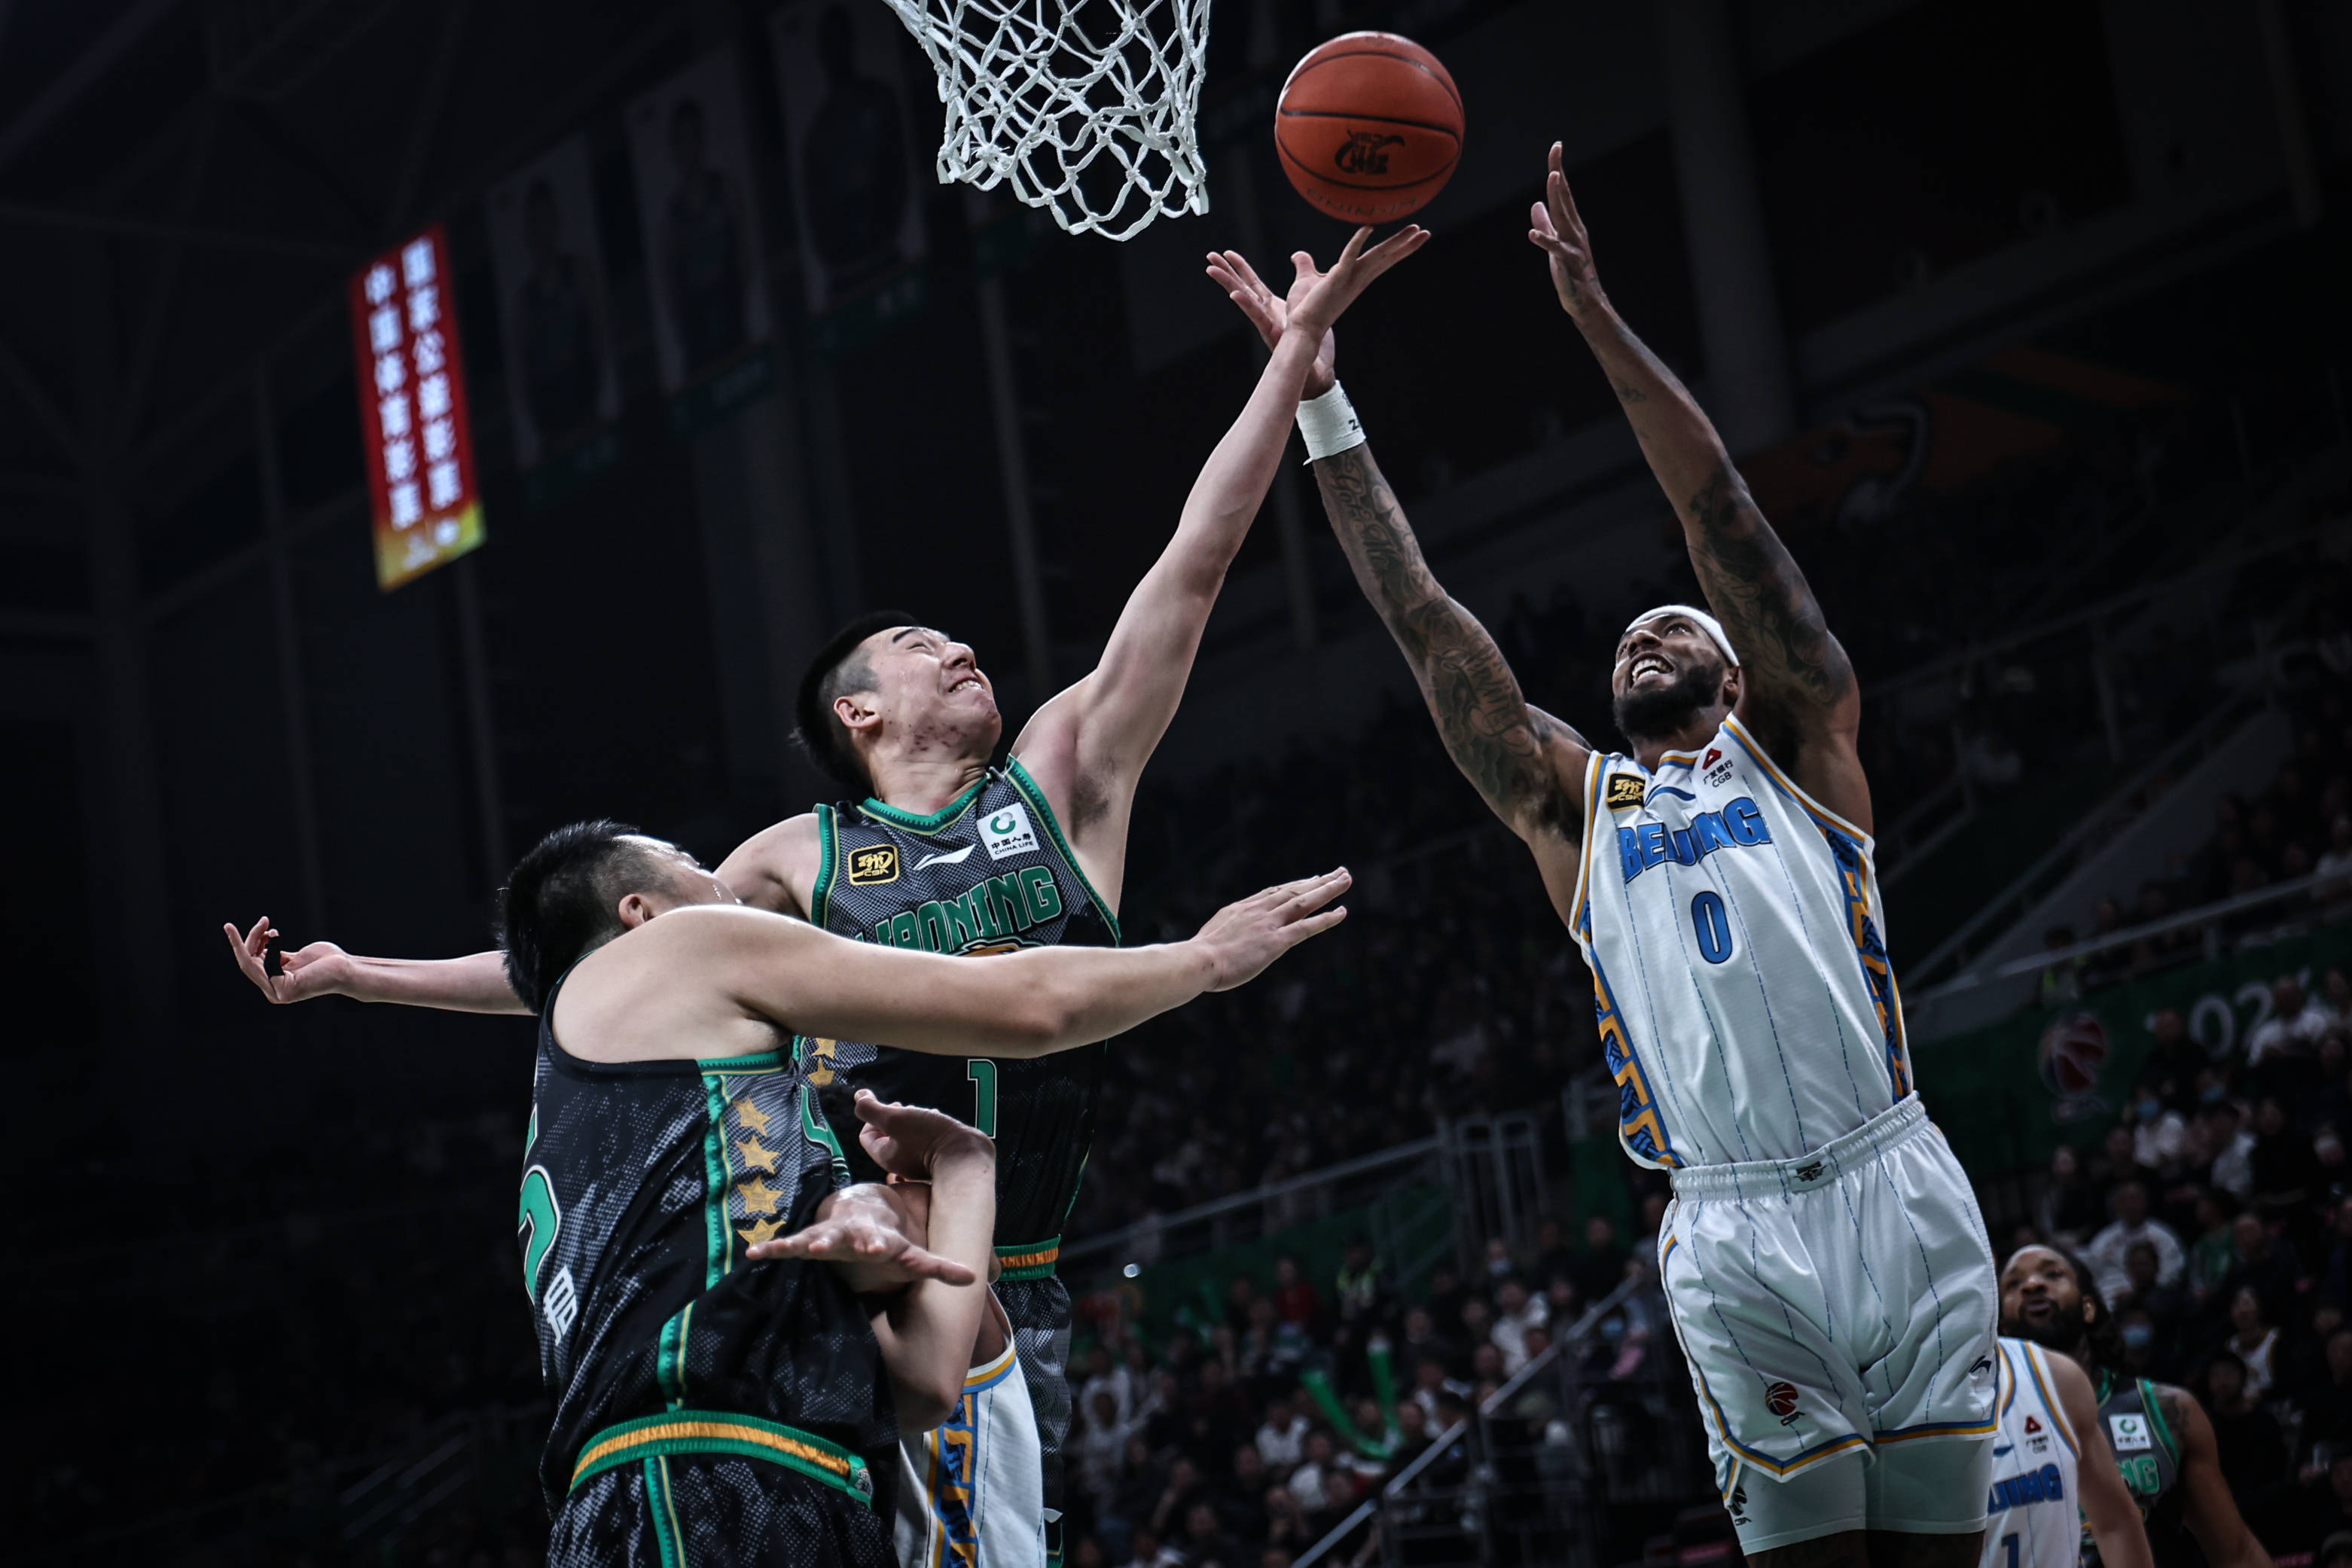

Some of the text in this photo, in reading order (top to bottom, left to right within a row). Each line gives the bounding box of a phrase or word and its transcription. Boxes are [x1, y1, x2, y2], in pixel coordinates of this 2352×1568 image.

[1712, 771, 1732, 788] CGB
[994, 845, 1017, 856] CHINA
[856, 865, 1062, 956] AONING
[1691, 891, 1733, 964] 0
[2002, 1533, 2019, 1568] 1
